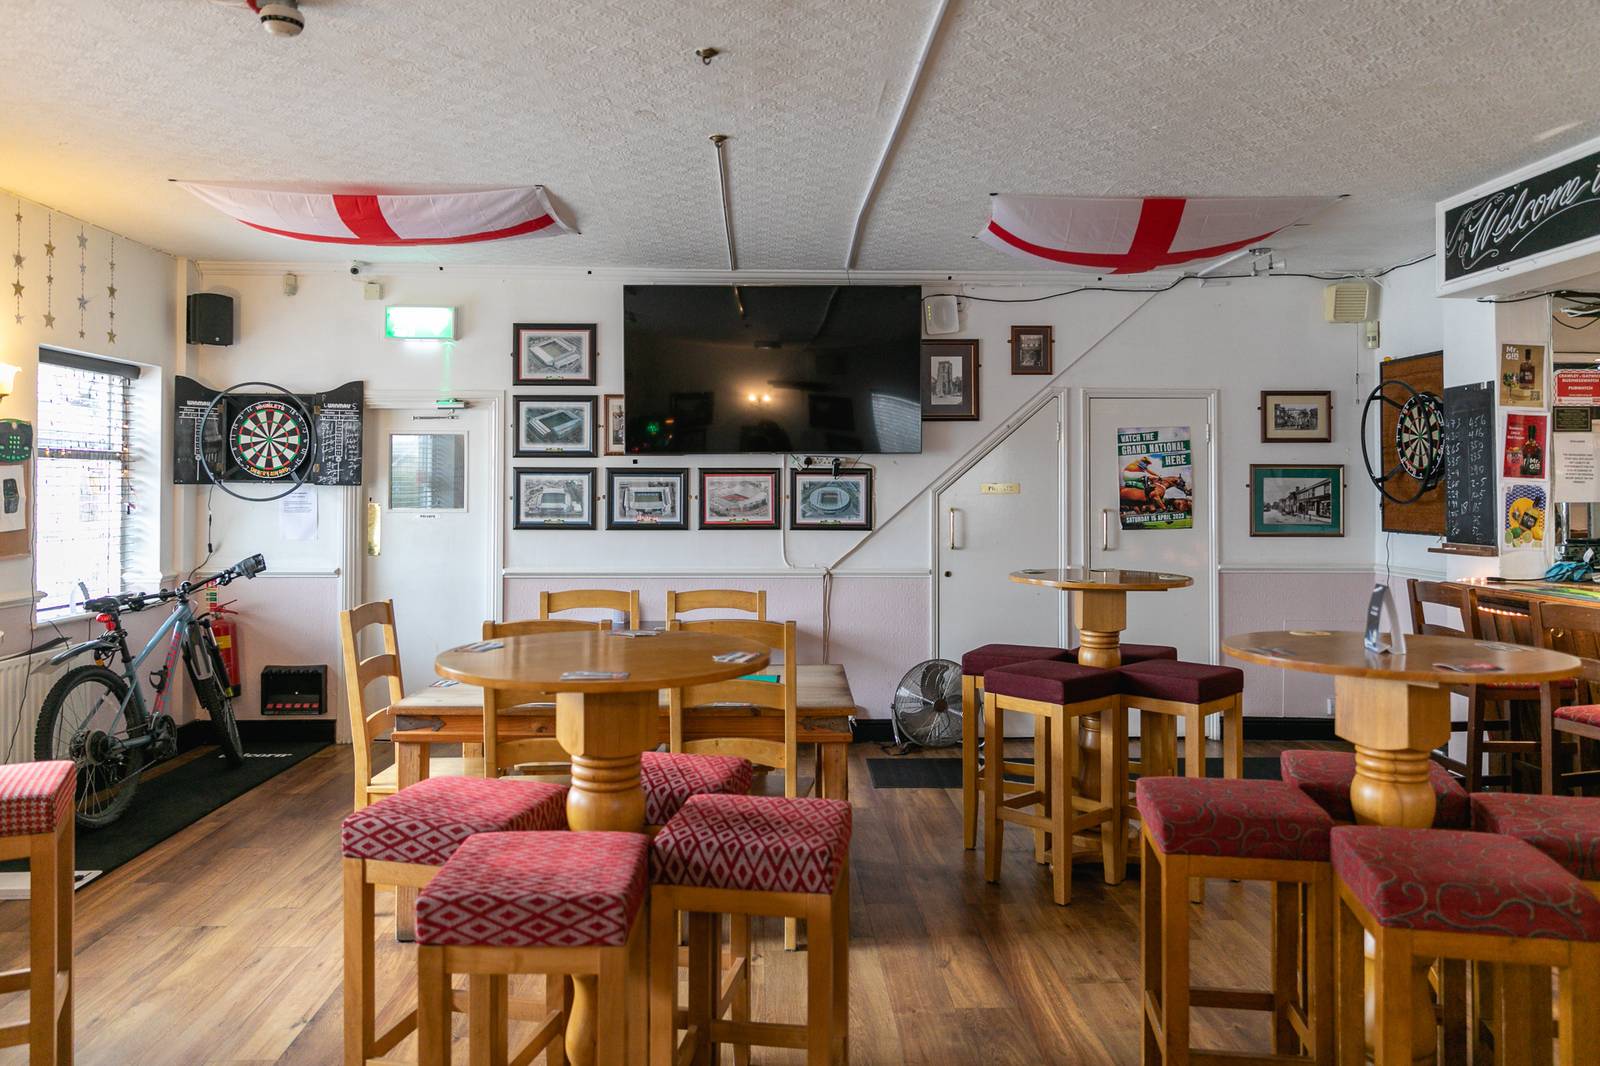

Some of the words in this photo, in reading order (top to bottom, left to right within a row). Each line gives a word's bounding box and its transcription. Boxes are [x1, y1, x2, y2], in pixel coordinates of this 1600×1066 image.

[1468, 176, 1591, 258] Welcome
[1120, 434, 1140, 442] WATCH
[1142, 432, 1154, 441] THE
[1121, 445, 1146, 455] GRAND
[1149, 442, 1186, 453] NATIONAL
[1165, 455, 1187, 465] HERE
[1126, 515, 1150, 524] SATURDAY
